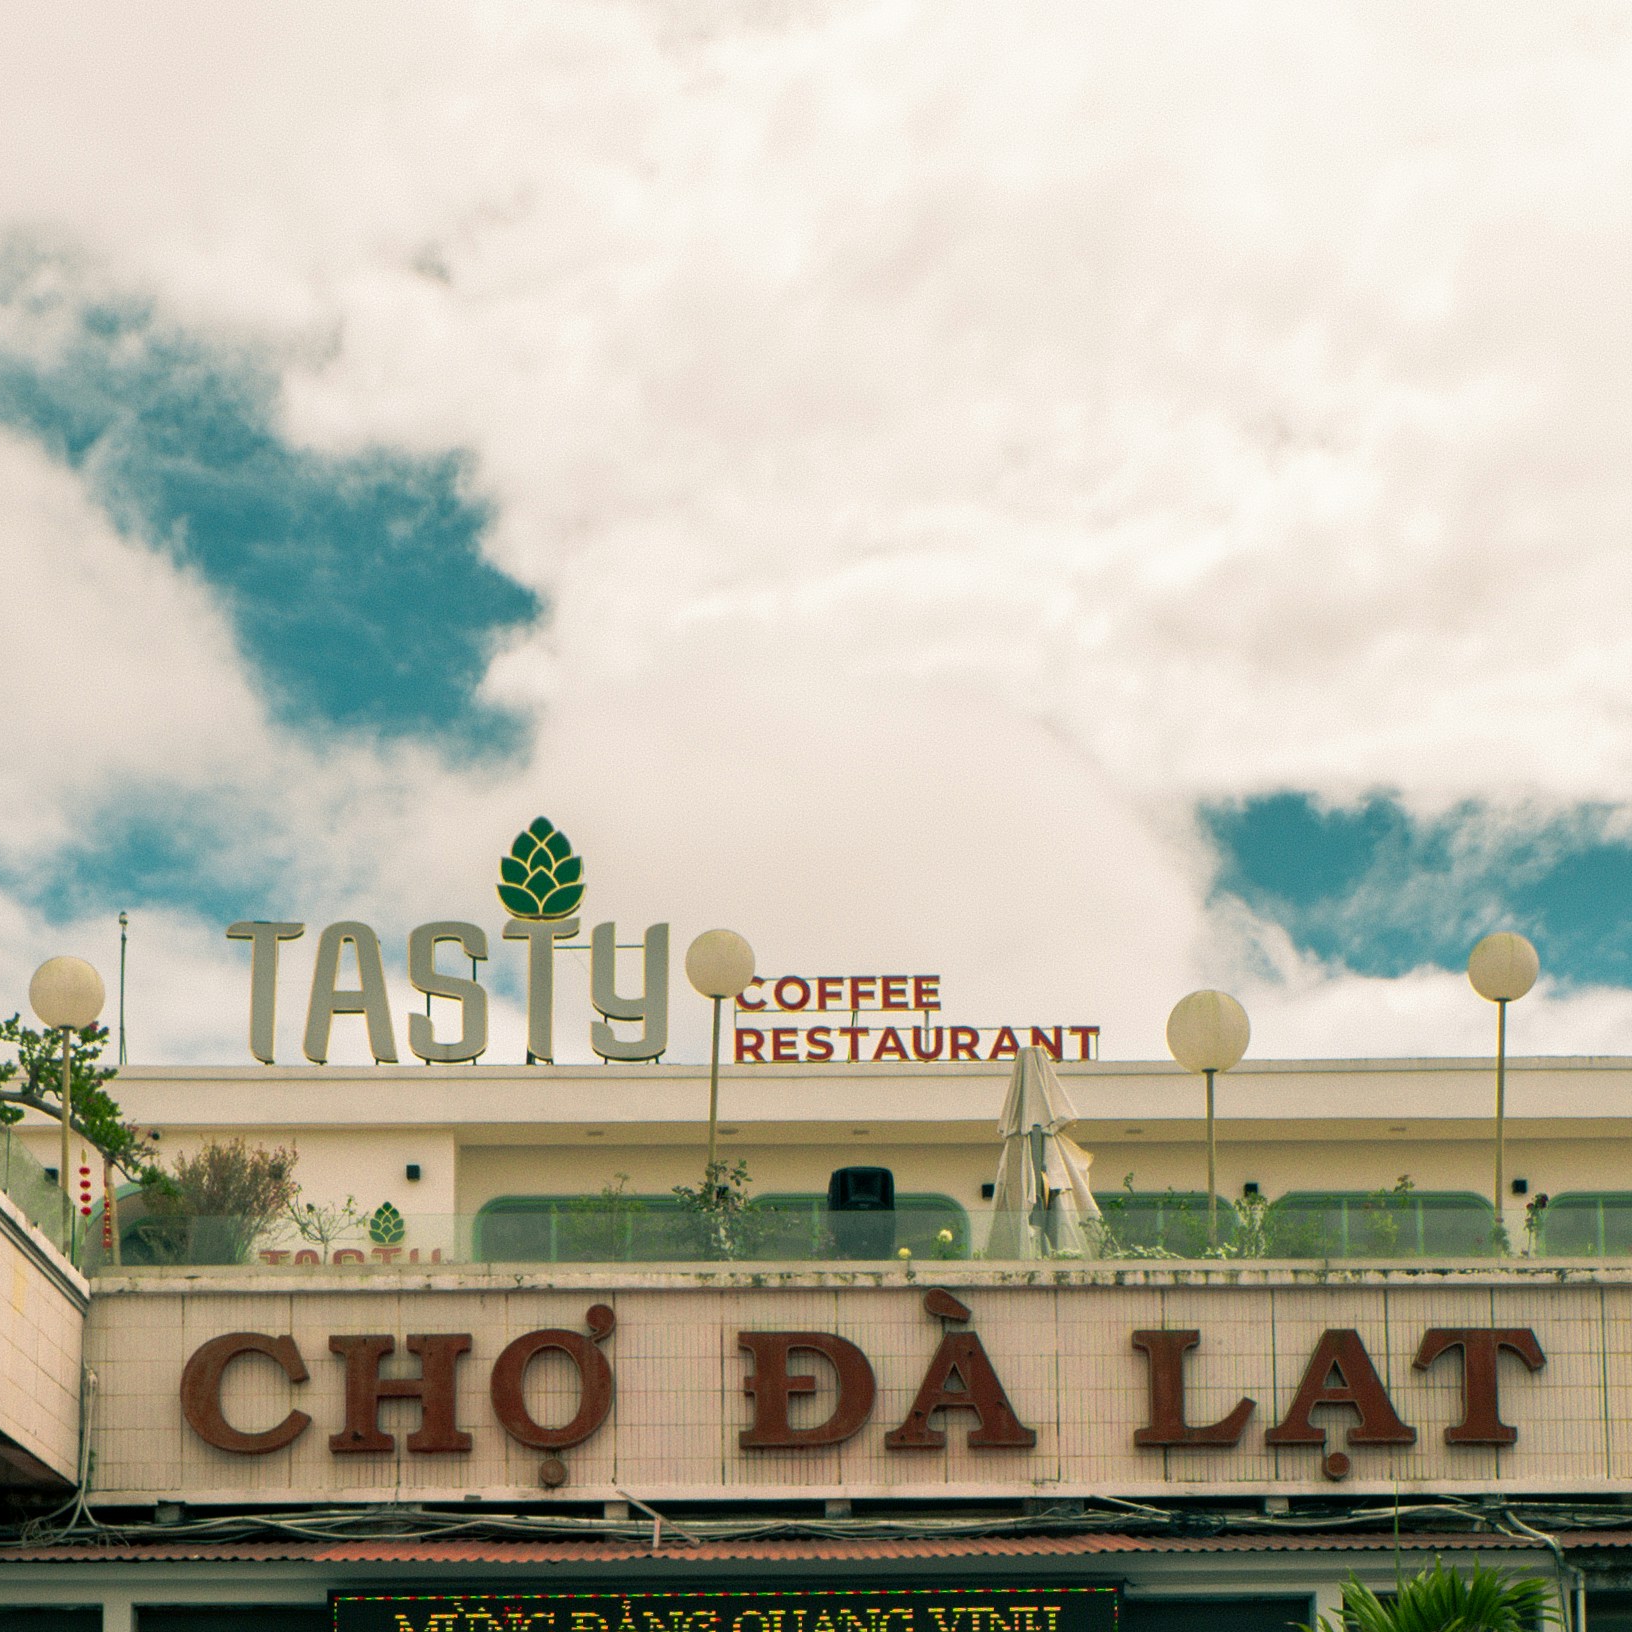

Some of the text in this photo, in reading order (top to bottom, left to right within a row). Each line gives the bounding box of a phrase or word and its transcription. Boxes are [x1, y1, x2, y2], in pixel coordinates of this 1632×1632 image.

[226, 918, 670, 1064] TASTY
[735, 974, 943, 1012] COFFEE
[734, 1025, 1101, 1062] RESTAURANT
[180, 1288, 1548, 1488] CHỢ ĐÀ LẠT
